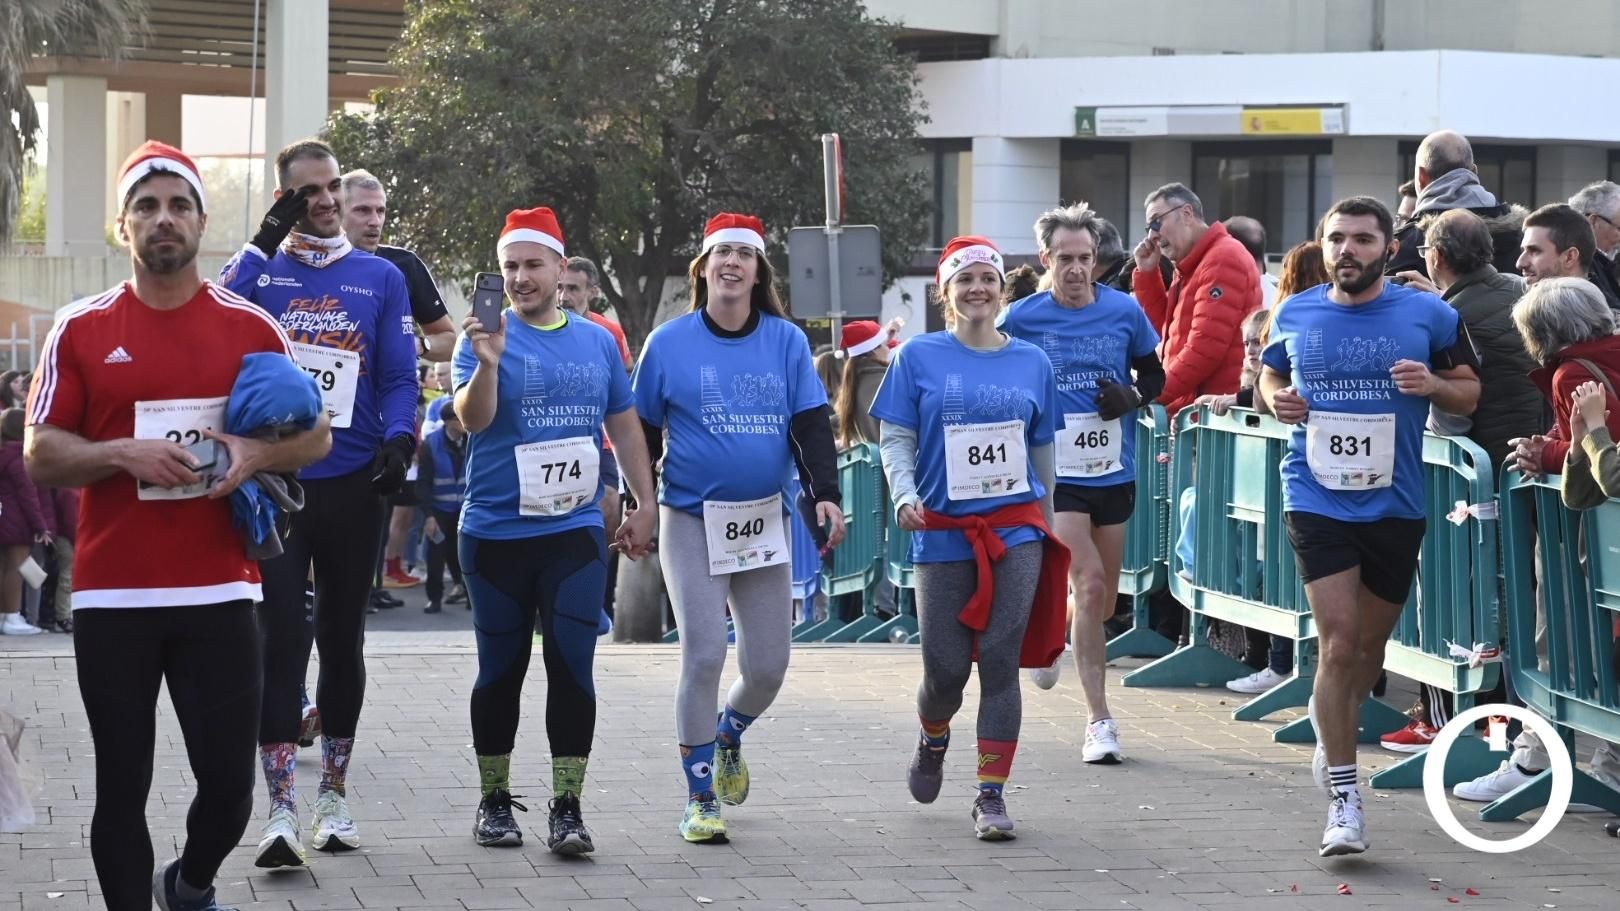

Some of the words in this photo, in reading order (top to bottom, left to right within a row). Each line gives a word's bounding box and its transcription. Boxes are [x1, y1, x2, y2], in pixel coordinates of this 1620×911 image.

[340, 284, 373, 297] OYSHO
[287, 294, 344, 312] FELIZ
[280, 310, 348, 322] NATIONALE
[104, 356, 133, 364] adidas
[301, 366, 336, 391] 79
[1306, 381, 1329, 391] SAN
[1313, 390, 1391, 401] CORDOBESA
[521, 406, 545, 417] SAN
[702, 414, 726, 425] SAN
[729, 414, 785, 424] SILVESTRE
[710, 424, 779, 435] CORDOBESA
[1074, 429, 1109, 449] 466
[1330, 435, 1371, 456] 831
[968, 443, 1006, 465] 841
[541, 459, 581, 484] 774
[725, 517, 764, 541] 840
